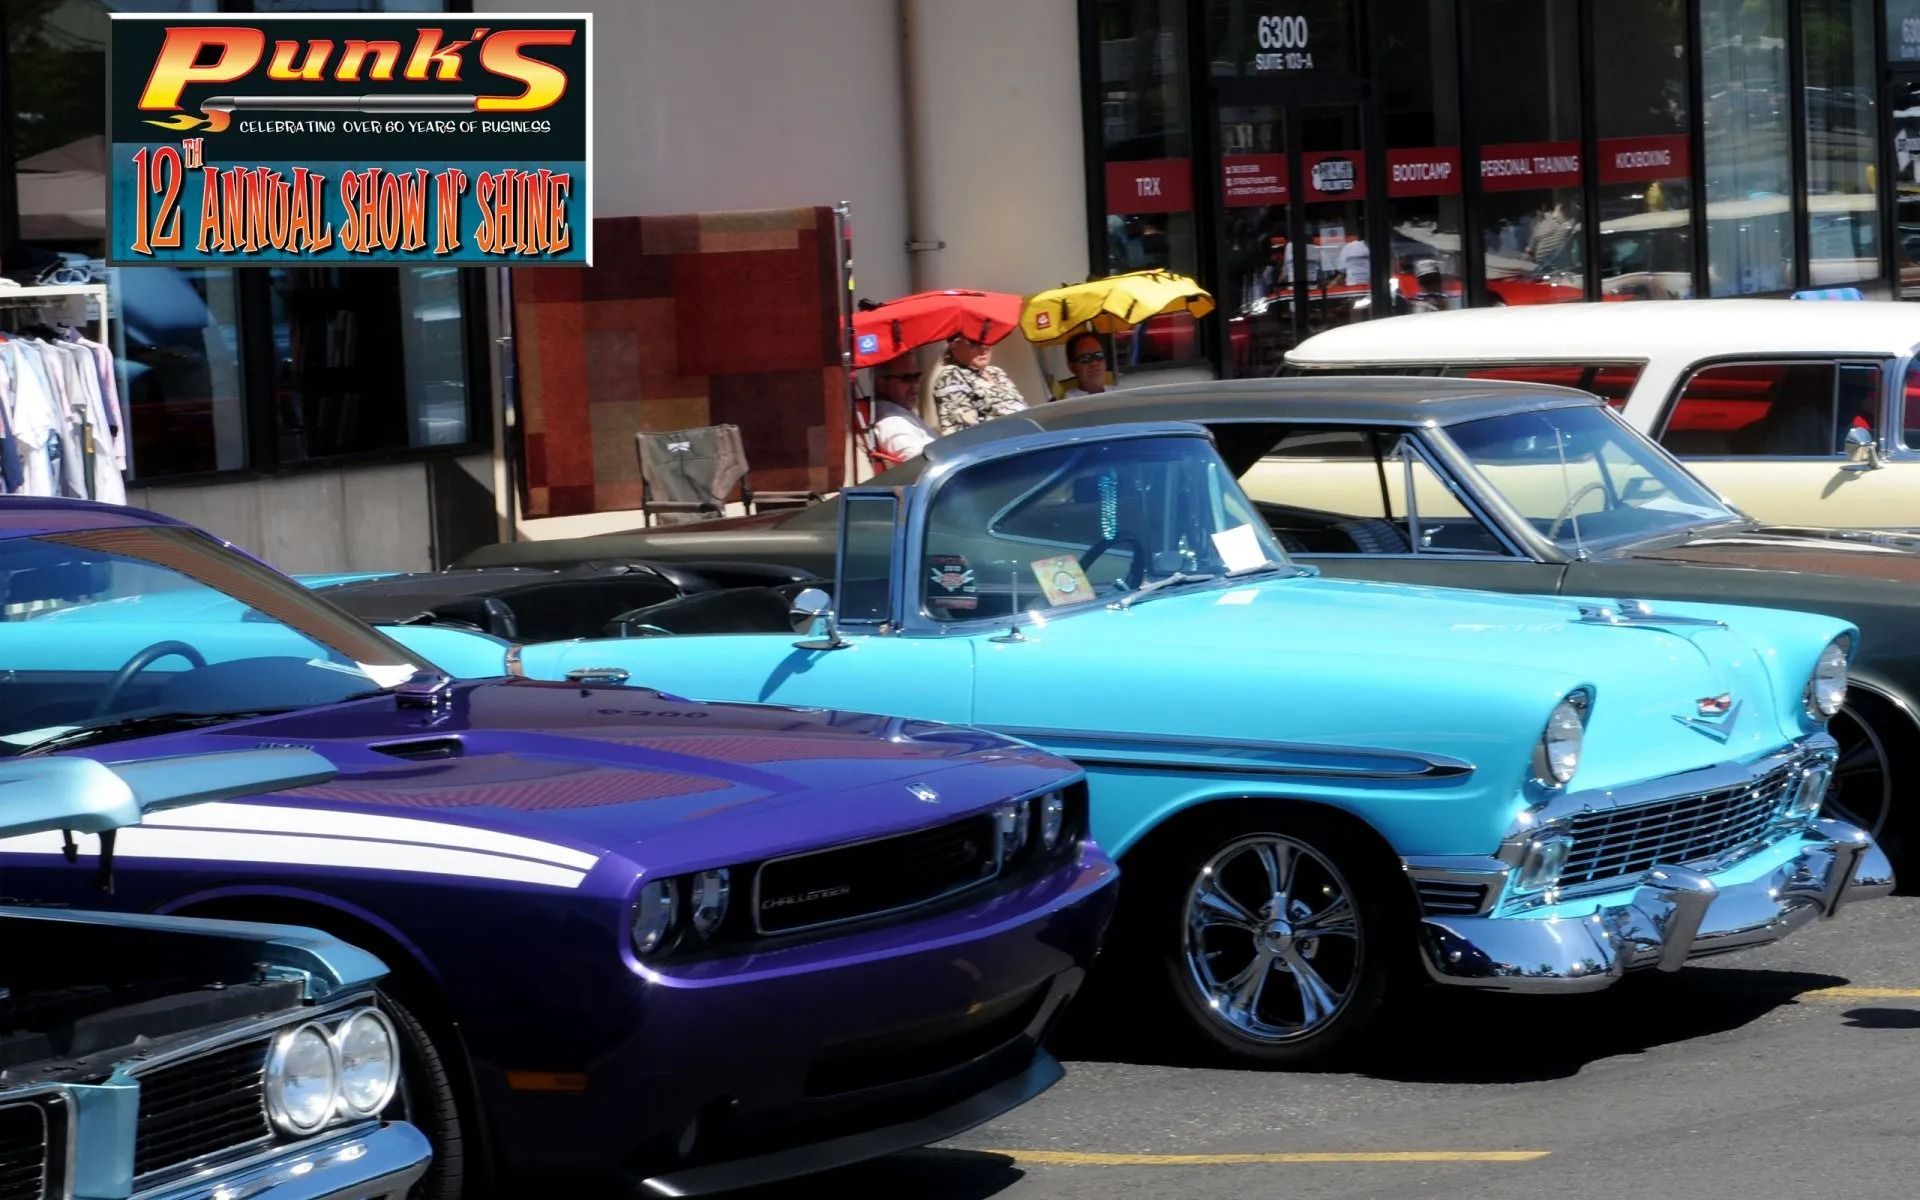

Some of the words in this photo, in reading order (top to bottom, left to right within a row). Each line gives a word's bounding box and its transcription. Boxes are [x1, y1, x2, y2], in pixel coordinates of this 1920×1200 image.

[1258, 15, 1308, 49] 6300
[1255, 53, 1284, 70] SUITE
[1480, 157, 1532, 177] PERSONAL
[1532, 155, 1580, 174] TRAINING
[1615, 150, 1672, 168] KICKBOXING
[1392, 162, 1452, 182] BOOTCAMP
[1135, 177, 1161, 196] TRX
